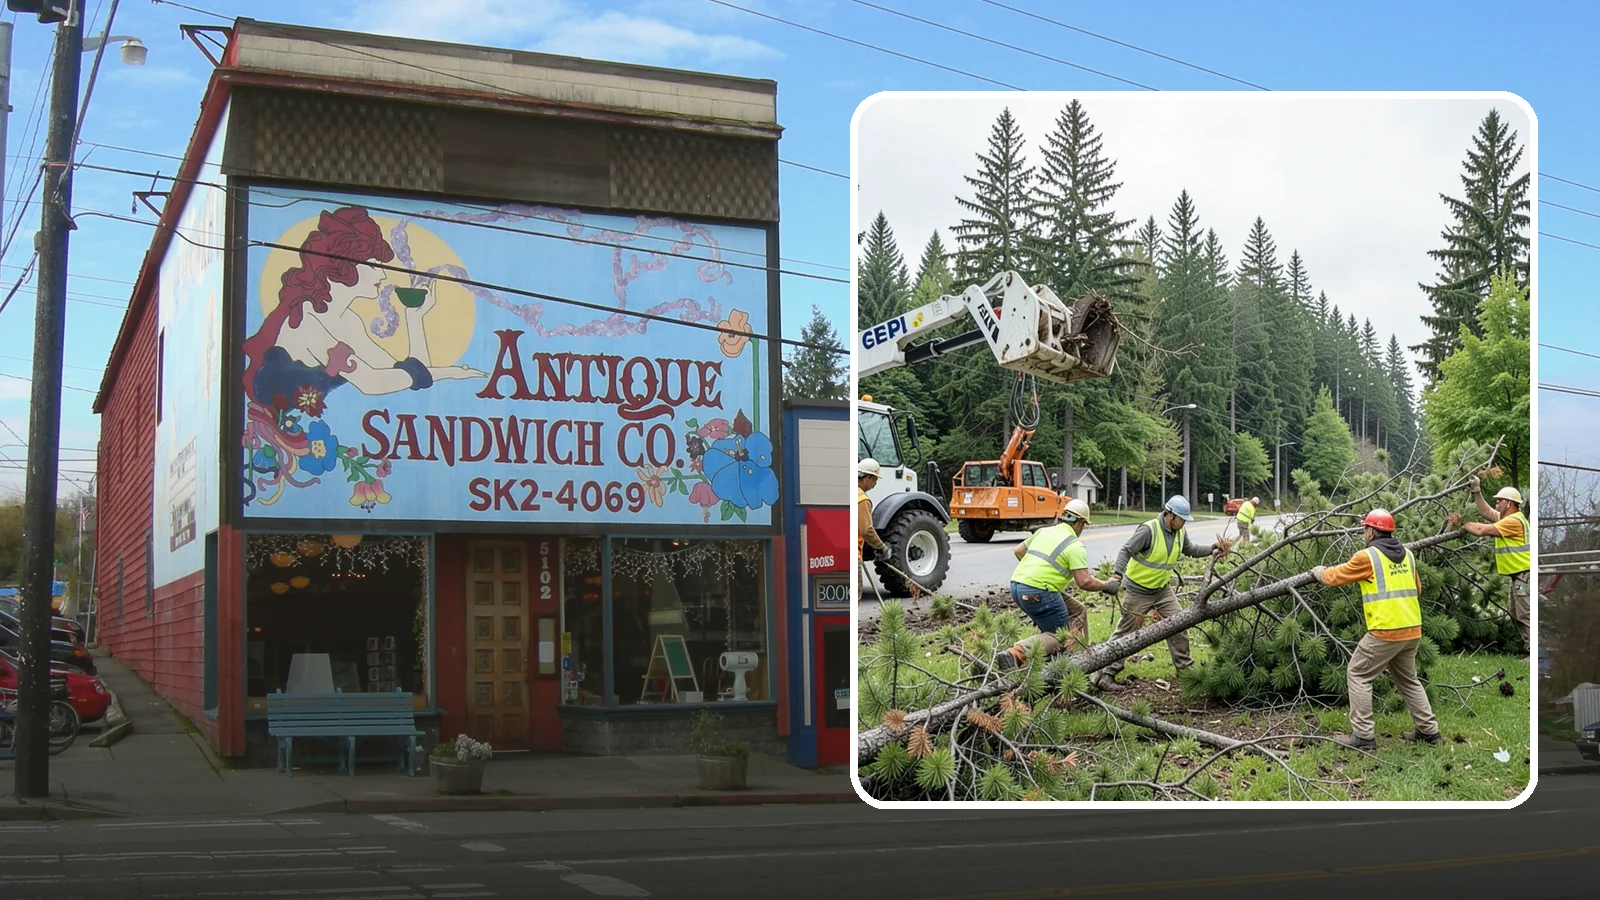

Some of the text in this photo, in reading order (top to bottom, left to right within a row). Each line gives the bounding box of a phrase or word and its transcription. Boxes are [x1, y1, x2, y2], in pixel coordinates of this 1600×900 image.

[862, 316, 908, 350] GEPI
[476, 329, 724, 420] ANTIQUE
[361, 408, 685, 468] SANDWICH CO.
[468, 477, 646, 513] SK2-4069
[540, 541, 552, 600] 5102
[809, 555, 835, 569] BOOKS
